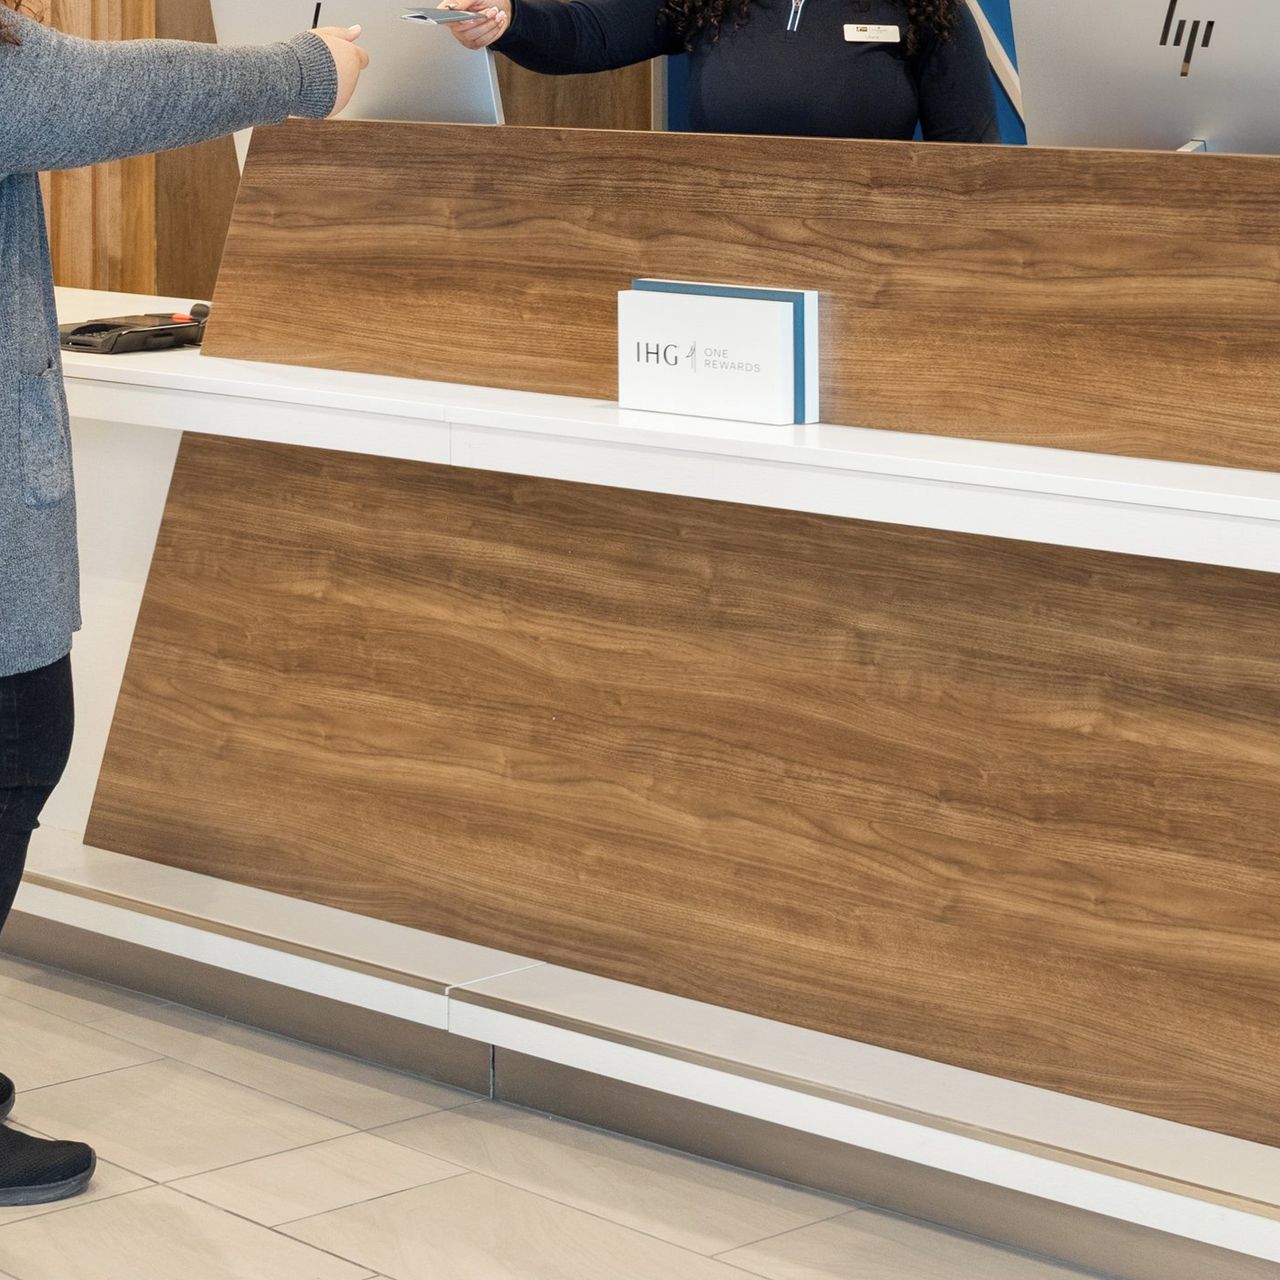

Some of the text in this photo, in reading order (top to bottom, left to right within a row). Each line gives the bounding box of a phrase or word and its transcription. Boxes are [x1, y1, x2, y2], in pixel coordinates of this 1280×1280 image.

[637, 341, 678, 366] IHG
[703, 347, 729, 359] ONE
[703, 359, 761, 373] REWARDS
